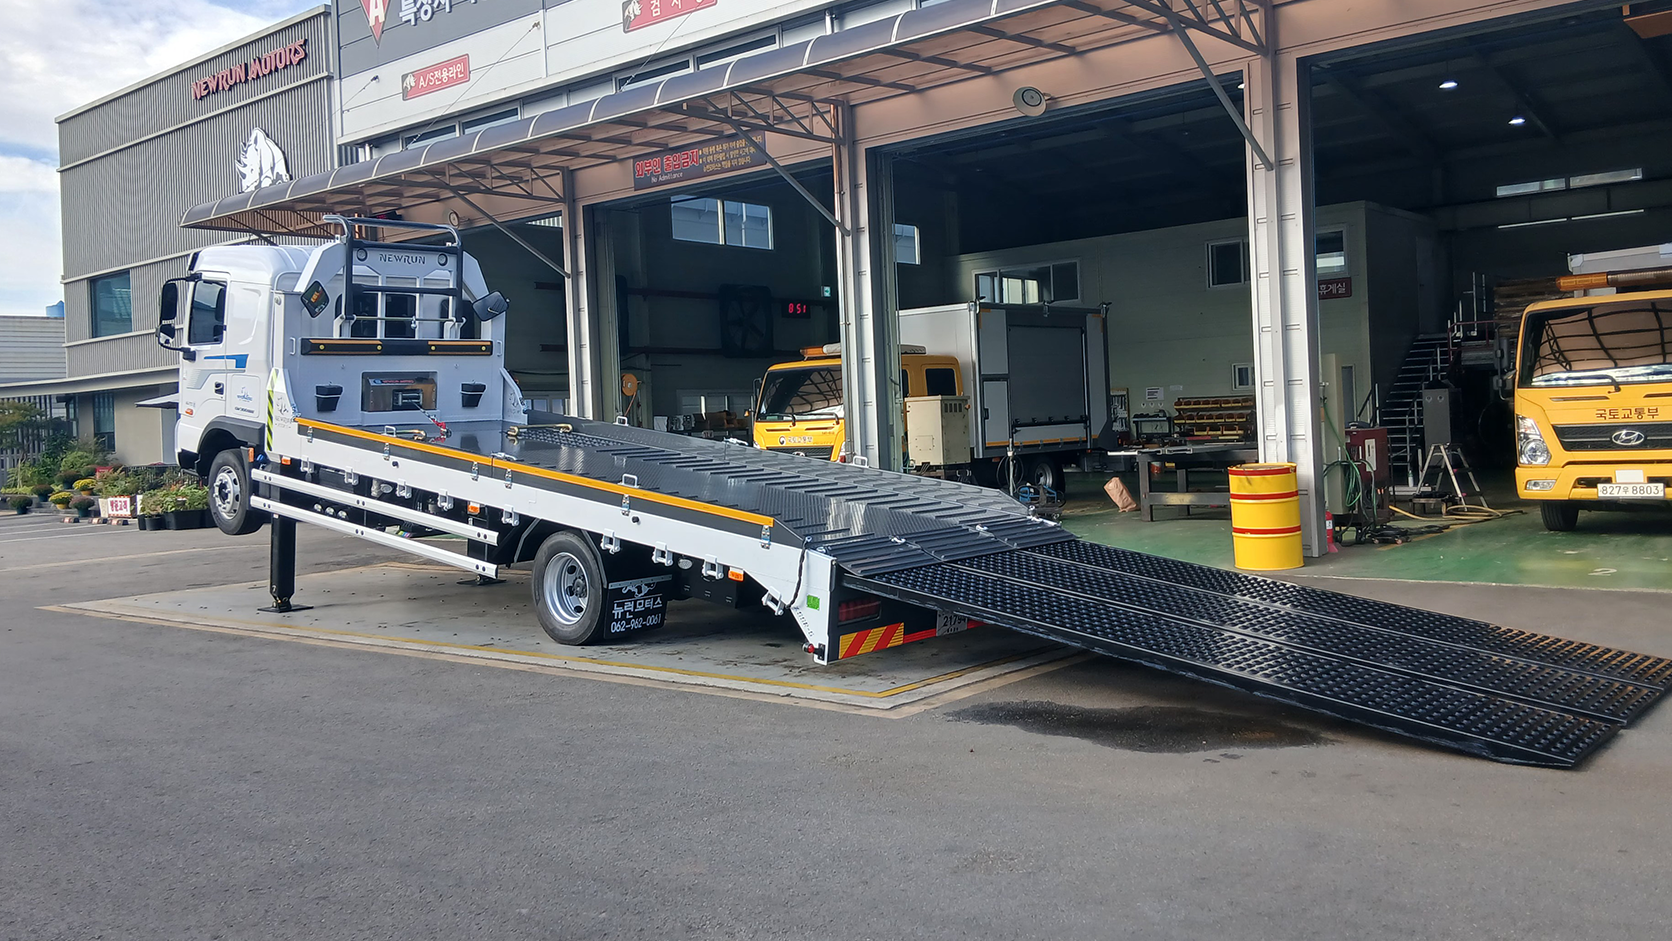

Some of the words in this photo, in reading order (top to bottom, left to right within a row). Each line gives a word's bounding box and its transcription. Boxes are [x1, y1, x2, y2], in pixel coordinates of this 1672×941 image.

[191, 62, 246, 100] NEWRUN
[247, 39, 306, 80] MOTORS
[419, 62, 464, 89] A/S전용라인
[635, 157, 661, 178] 외부인
[663, 149, 699, 172] 출입금지
[379, 253, 426, 265] NEWRUN
[1318, 282, 1346, 295] 휴게실
[1595, 407, 1659, 420] 국토교통부
[1601, 485, 1629, 495] 827우
[1631, 485, 1660, 495] 8803
[612, 597, 662, 619] 뉴런모터스
[610, 613, 661, 633] 062-962-0061
